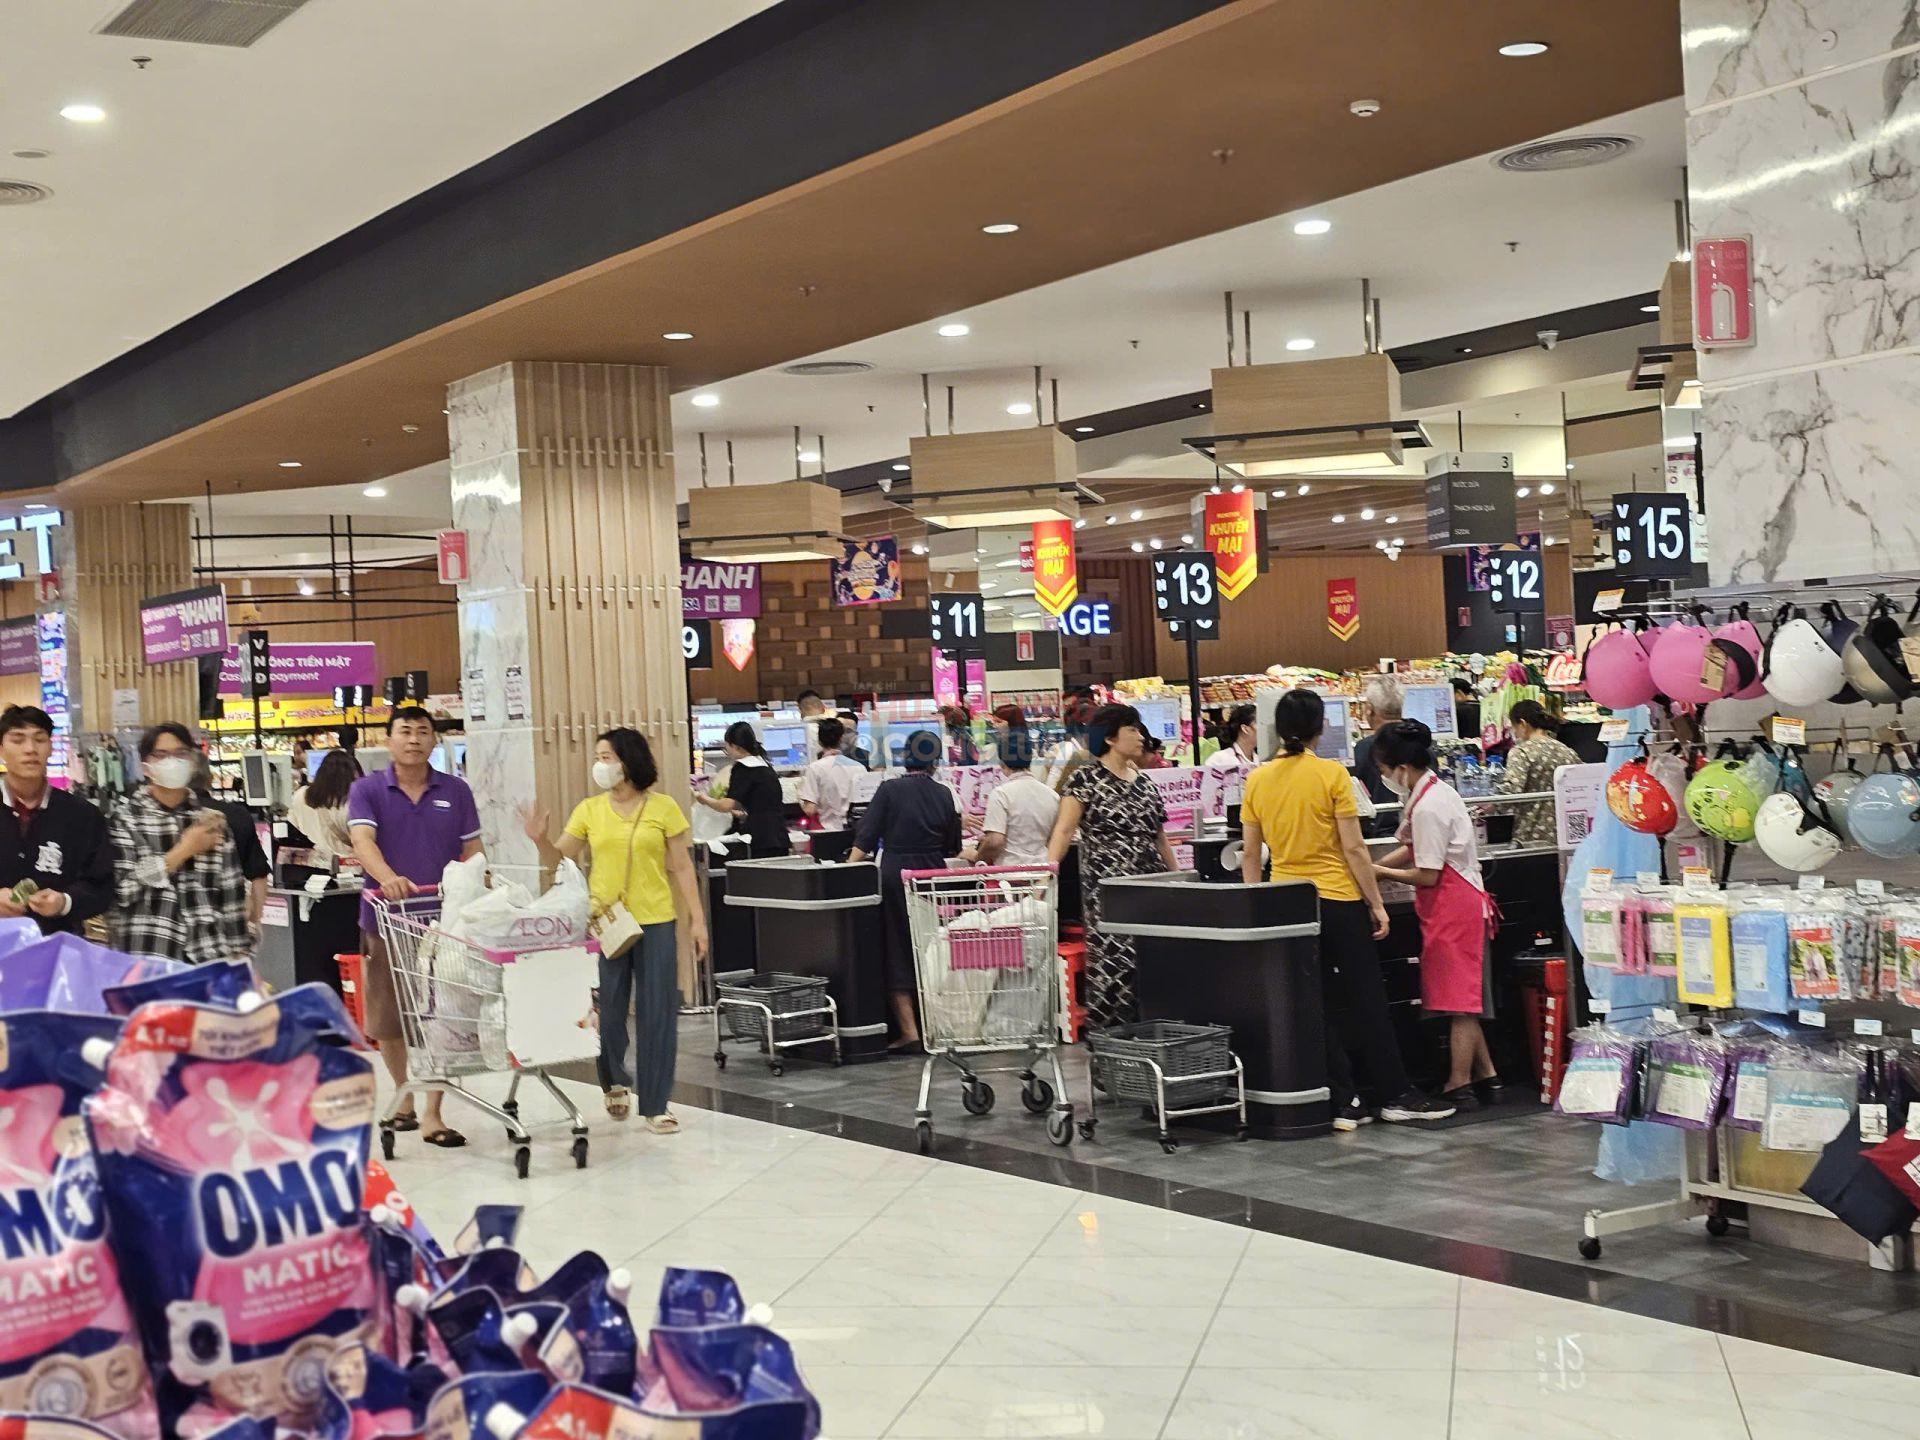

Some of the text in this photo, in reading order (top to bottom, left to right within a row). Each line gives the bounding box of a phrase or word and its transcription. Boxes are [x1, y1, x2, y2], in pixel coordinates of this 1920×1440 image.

[1452, 455, 1460, 469] 4
[1501, 456, 1509, 469] 3
[1217, 536, 1242, 557] MẠI
[1638, 506, 1684, 559] 15
[1172, 562, 1213, 605] 13
[1506, 560, 1540, 598] 12
[948, 601, 977, 637] 11
[681, 626, 700, 659] 9
[200, 1150, 360, 1257] OMO
[243, 1243, 349, 1293] MATIC
